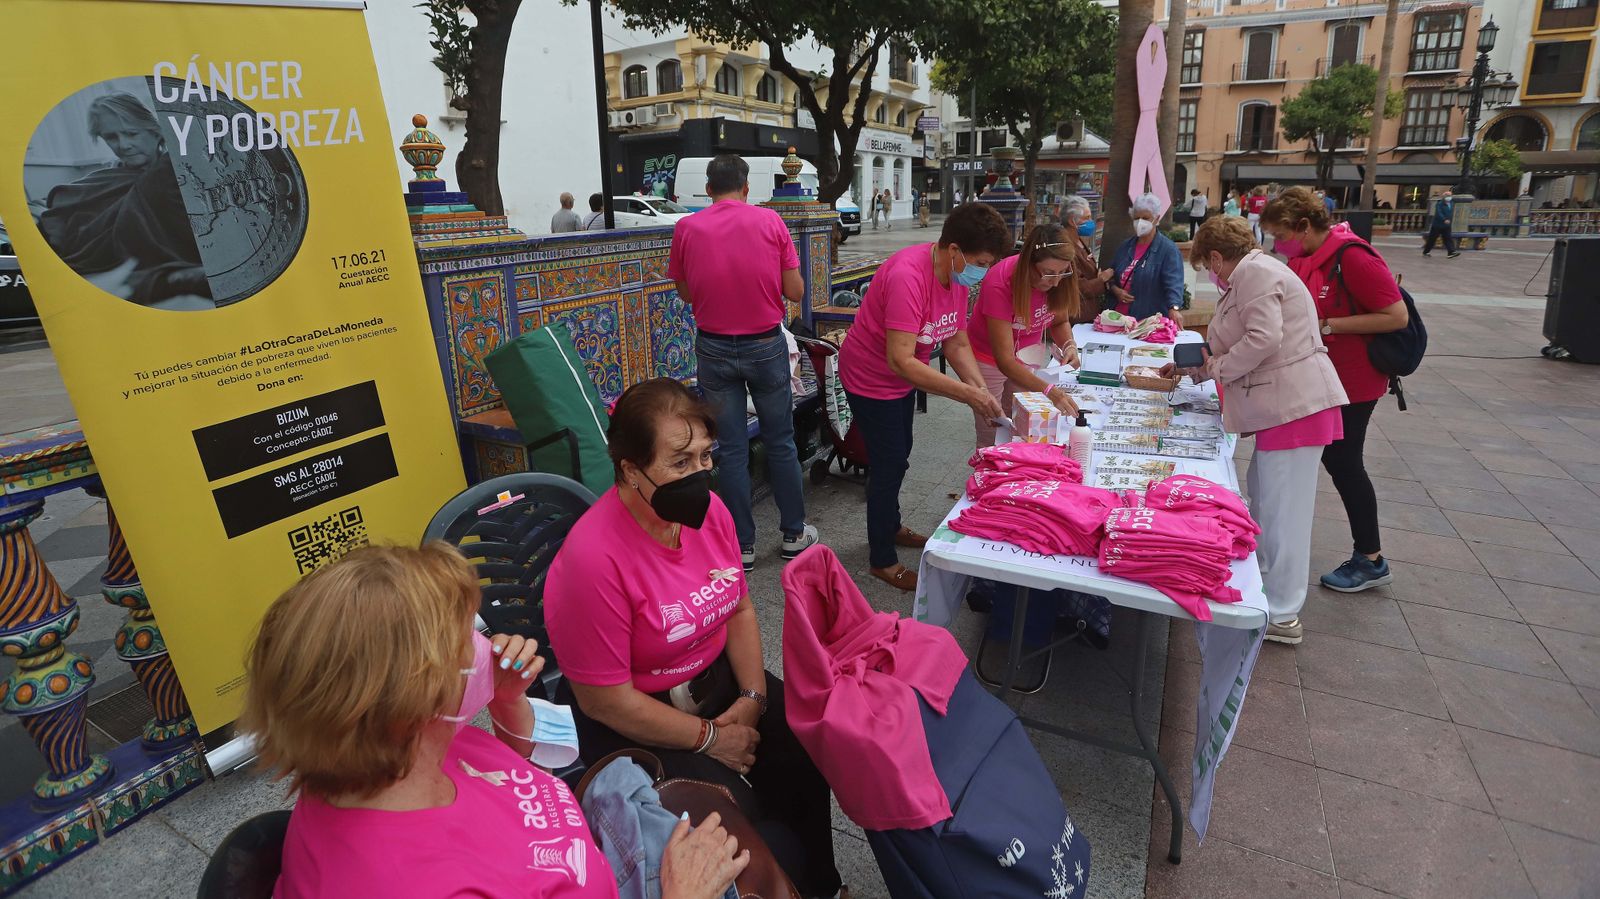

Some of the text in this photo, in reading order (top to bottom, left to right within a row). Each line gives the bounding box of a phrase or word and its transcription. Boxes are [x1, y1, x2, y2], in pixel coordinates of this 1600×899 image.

[153, 54, 303, 104] CÁNCER
[168, 107, 365, 156] Y POBREZA
[870, 139, 902, 153] BELLAFEMME
[643, 153, 677, 173] EVO
[331, 249, 387, 270] 17.06.21
[340, 266, 389, 280] Cuestación
[338, 273, 390, 290] Anual AECC
[122, 325, 398, 400] y mejorar la situación de pobreza que viven los pacientes
[134, 316, 384, 382] Tú puedes cambiar #LaOtraCaraDeLaMoneda
[217, 352, 332, 388] debido a la enfermedad.
[256, 372, 304, 393] Dona en:
[253, 412, 339, 446] Con el código 01046
[276, 406, 310, 427] BIZUM
[266, 425, 334, 454] Concepto: CÁDIZ
[274, 455, 344, 488] SMS AL 28014
[289, 471, 337, 496] AECC CÁDIZ
[980, 542, 1005, 553] TU
[689, 577, 733, 607] aecc
[699, 592, 729, 615] ALGECIRAS
[662, 659, 704, 675] GenesisCare
[510, 768, 549, 830] aecc
[540, 784, 561, 829] ALGECIRAS
